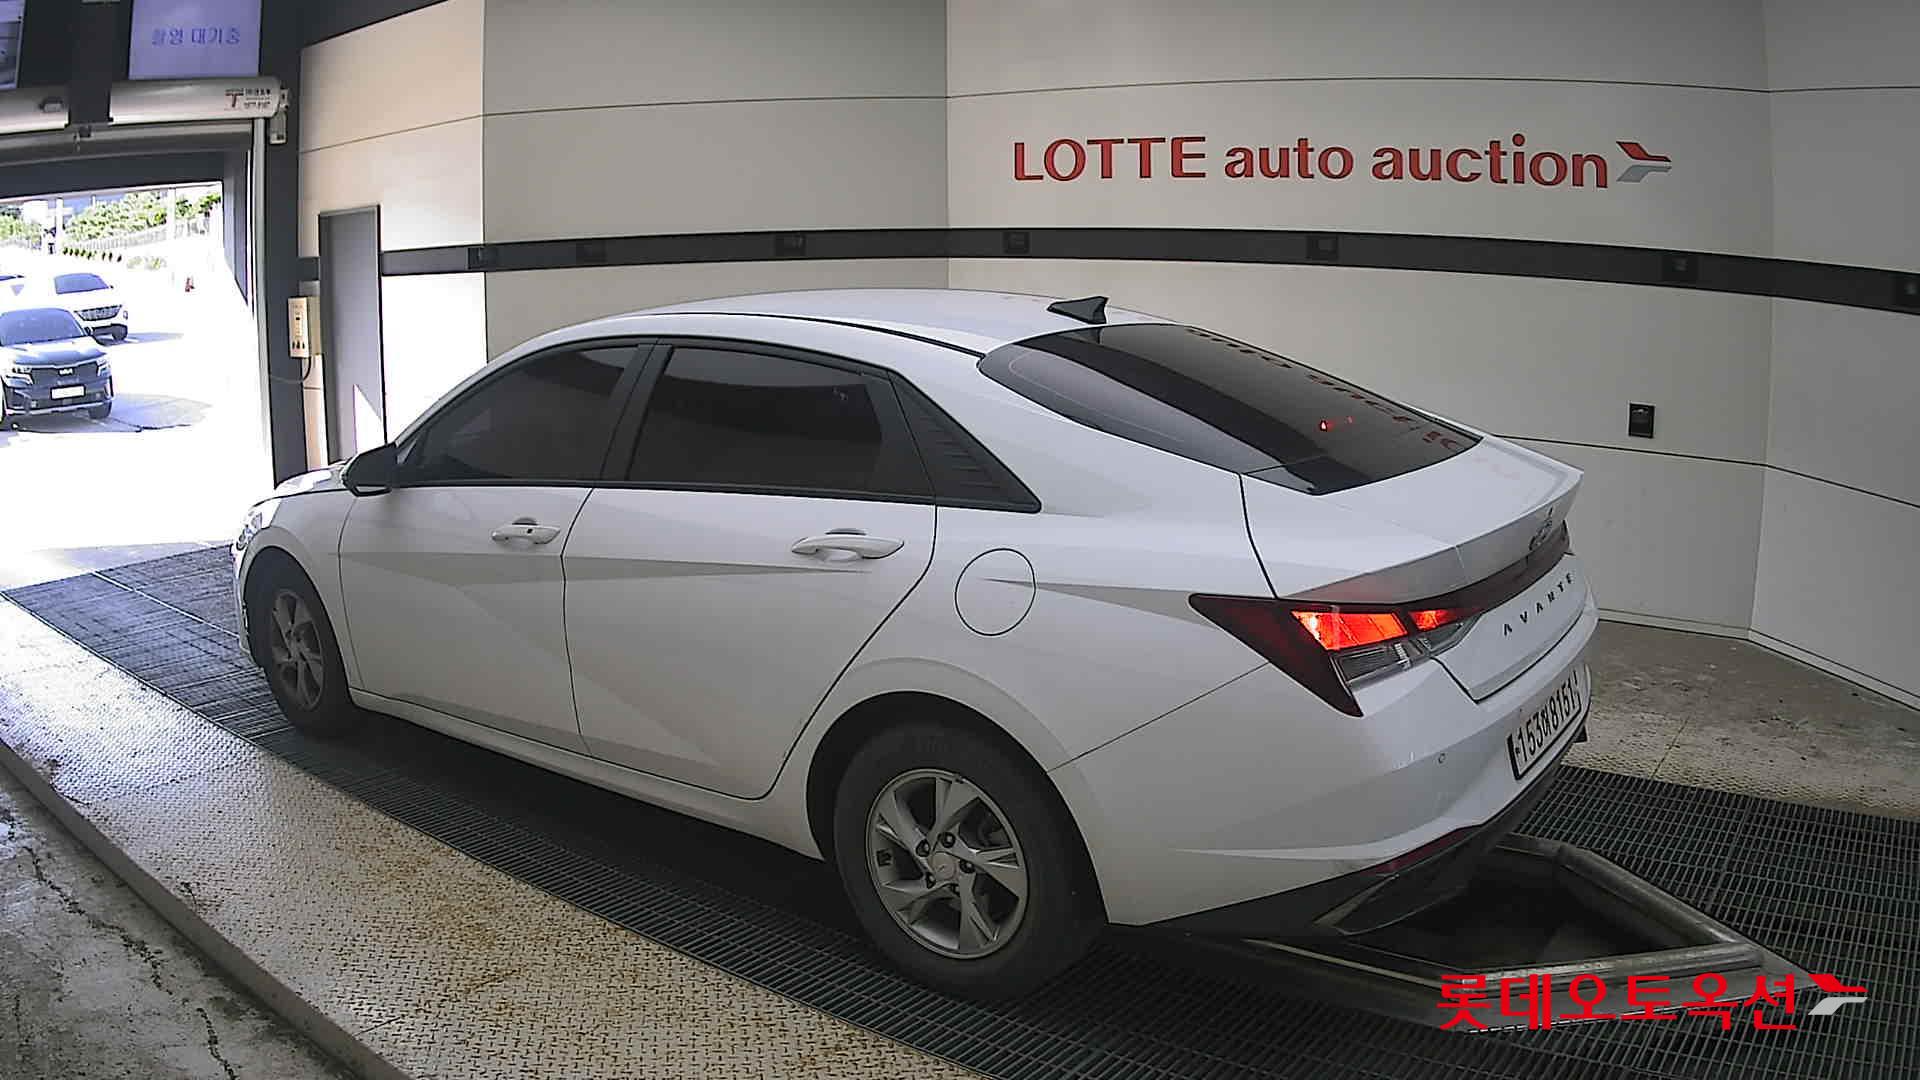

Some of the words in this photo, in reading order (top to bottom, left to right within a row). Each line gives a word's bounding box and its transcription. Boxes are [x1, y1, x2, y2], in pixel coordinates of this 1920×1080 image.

[1014, 136, 1207, 181] LOTTE
[1224, 137, 1354, 180] auto
[1371, 133, 1608, 189] auction
[1503, 572, 1573, 636] AVANTE
